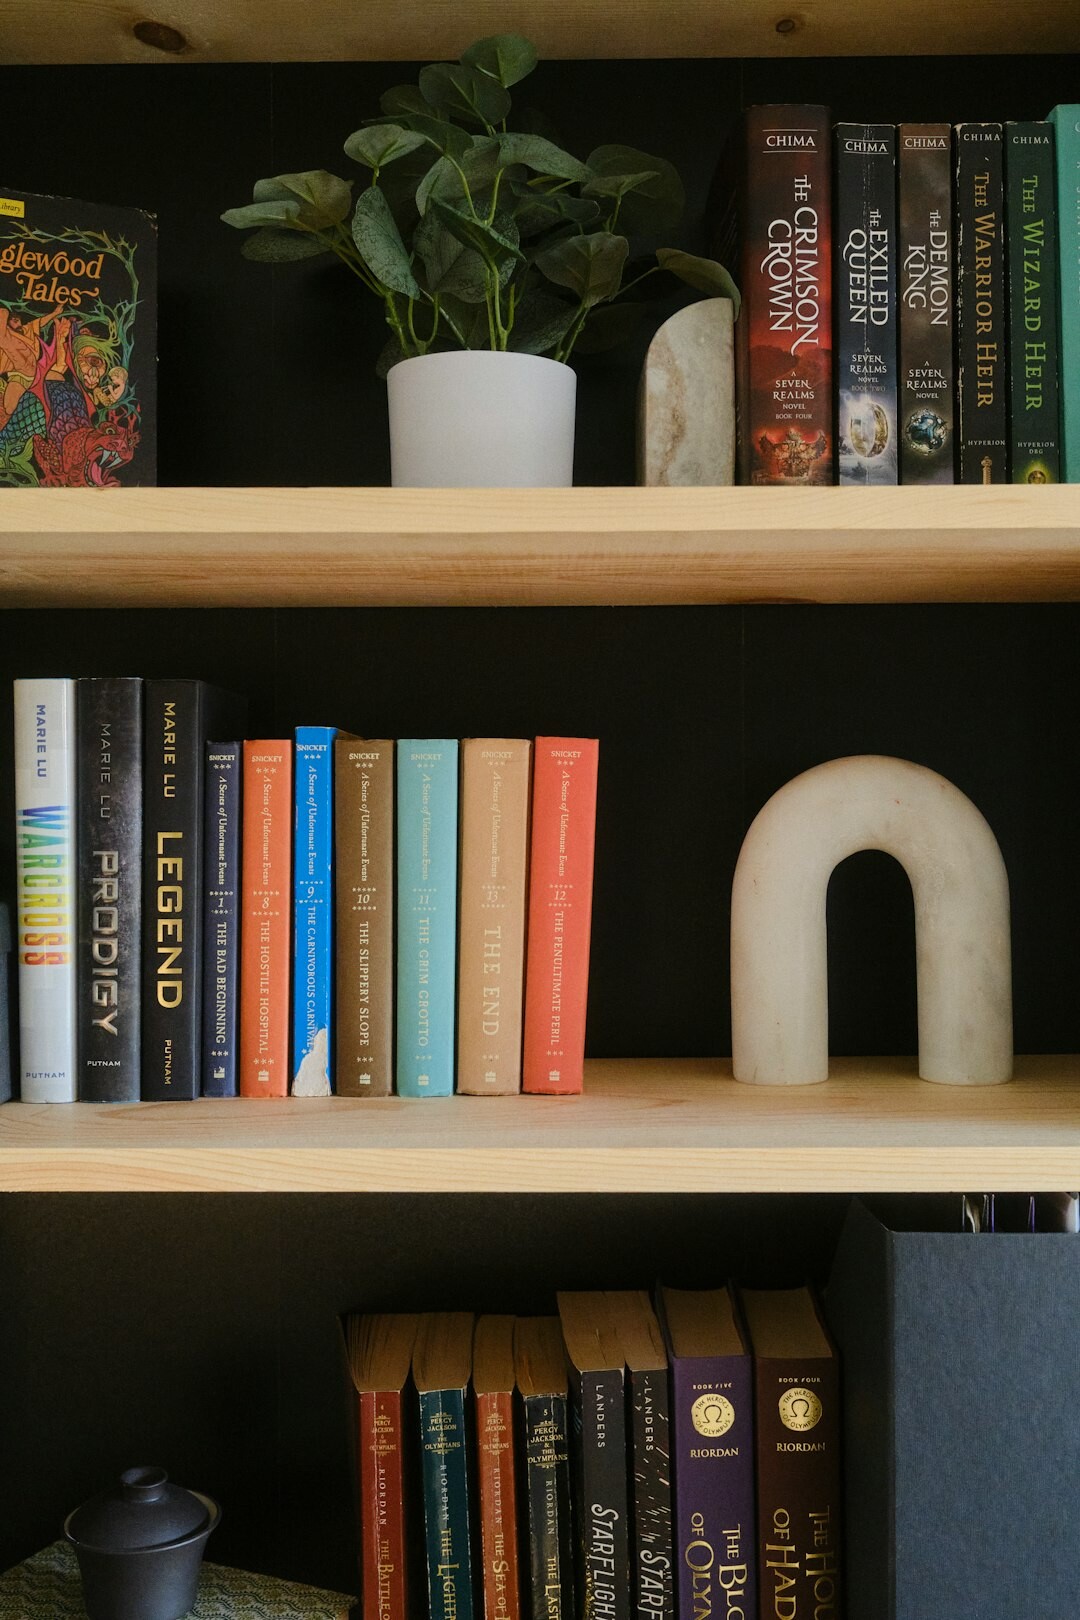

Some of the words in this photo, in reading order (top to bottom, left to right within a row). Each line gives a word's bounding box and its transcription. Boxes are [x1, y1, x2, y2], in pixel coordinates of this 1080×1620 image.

[766, 135, 816, 147] CHIMA
[845, 141, 888, 152] CHIMA
[904, 138, 946, 148] CHIMA
[963, 133, 1001, 141] CHIMA
[1012, 136, 1050, 144] CHIMA
[794, 174, 812, 202] THE
[974, 172, 990, 208] THE
[1022, 175, 1038, 213] THE
[0, 202, 21, 214] ibrary
[869, 208, 882, 227] THE
[929, 209, 941, 228] THE
[760, 218, 793, 332] CROWN
[791, 206, 819, 356] CRIMSON
[842, 228, 868, 325] QUEEN
[869, 229, 889, 326] EXILED
[902, 244, 930, 309] KING
[929, 230, 949, 327] DEMON
[974, 211, 996, 335] WARRIOR
[1022, 219, 1045, 332] WIZARD
[16, 271, 100, 306] Tales
[850, 364, 887, 375] REALMS
[851, 354, 885, 364] SEVEN
[775, 379, 812, 390] SEVEN
[906, 380, 948, 391] REALMS
[908, 369, 945, 379] SEVEN
[976, 342, 998, 408] HEIR
[1024, 341, 1047, 411] HEIR
[773, 391, 815, 402] REALMS
[36, 704, 47, 754] MARIE
[163, 702, 176, 765] MARIE
[100, 723, 111, 784] MARIE
[251, 755, 283, 763] SNICKET
[296, 744, 327, 752] SNICKET
[349, 752, 380, 760] SNICKET
[410, 753, 442, 761] SNICKET
[481, 751, 513, 759] SNICKET
[551, 750, 581, 758] SNICKET
[36, 759, 47, 778] LU
[163, 773, 176, 798] LU
[218, 784, 228, 806] Series
[308, 774, 317, 795] Series
[361, 780, 370, 802] Series
[561, 780, 570, 802] Series
[100, 795, 111, 819] LU
[217, 807, 226, 816] of
[306, 797, 317, 807] of
[359, 803, 370, 812] of
[559, 803, 570, 812] of
[218, 818, 228, 860] Unfortunate
[308, 808, 317, 851] Unfortunate
[361, 814, 370, 857] Unfortunate
[560, 814, 570, 854] Unfortunate
[218, 862, 228, 885] Events
[308, 852, 317, 875] Events
[361, 858, 370, 882] Events
[559, 855, 568, 877] Events
[19, 805, 71, 966] WARCROSS
[307, 886, 315, 898] 9
[487, 891, 499, 903] 13
[554, 890, 567, 901] 12
[217, 898, 224, 908] 1
[262, 898, 269, 909] 8
[356, 894, 370, 904] 10
[418, 894, 430, 905] 11
[157, 831, 184, 1009] LEGEND
[307, 906, 316, 926] THE
[554, 911, 564, 933] THE
[216, 922, 227, 946] THE
[260, 920, 270, 943] THE
[359, 921, 369, 945] THE
[419, 917, 430, 944] THE
[92, 850, 119, 1037] PRODIGY
[484, 925, 502, 974] THE
[216, 949, 227, 974] BAD
[260, 946, 270, 995] HOSTILE
[307, 928, 316, 998] CARNIVOROUS
[418, 949, 430, 985] GRIM
[359, 948, 369, 1004] SLIPPERY
[552, 936, 563, 1013] PENULTIMATE
[215, 976, 227, 1044] BEGINNING
[418, 989, 430, 1047] GROTTO
[482, 986, 501, 1036] END
[259, 998, 269, 1055] HOSPITAL
[359, 1007, 369, 1046] SLOPE
[550, 1015, 561, 1046] PERIL
[164, 1039, 172, 1086] PUTNAM
[25, 1071, 66, 1079] PUTNAM
[695, 1400, 705, 1410] THE
[706, 1396, 729, 1409] HEROES
[783, 1392, 793, 1404] THE
[430, 1417, 453, 1425] PERCY
[543, 1408, 548, 1416] 5
[595, 1384, 606, 1448] LANDERS
[644, 1387, 654, 1451] LANDERS
[790, 1411, 819, 1429] OLYMPUS
[427, 1424, 457, 1432] JACKSON
[530, 1434, 564, 1443] JACKSON
[534, 1426, 559, 1435] PERCY
[703, 1419, 730, 1435] OLYMPUS
[424, 1441, 461, 1450] OLYMPIANS
[690, 1447, 739, 1458] RIORDAN
[776, 1442, 826, 1452] RIORDAN
[528, 1454, 568, 1464] OLYMPIANS
[378, 1468, 387, 1525] RIORDAN
[440, 1465, 449, 1521] RIORDAN
[493, 1468, 502, 1524] RIORDAN
[546, 1480, 555, 1535] RIORDAN
[691, 1512, 704, 1537] OF
[773, 1507, 790, 1541] OF
[808, 1504, 830, 1547] THE
[380, 1539, 389, 1560] THE
[441, 1527, 453, 1556] THE
[495, 1533, 505, 1556] THE
[722, 1523, 741, 1560] THE
[547, 1556, 558, 1580] THE
[589, 1503, 619, 1620] STARFLIGH
[379, 1563, 394, 1610] BATTLE
[492, 1560, 511, 1592] SEA
[765, 1543, 800, 1620] HAD
[437, 1562, 459, 1620] LIGHT
[544, 1583, 561, 1620] LAST
[496, 1597, 507, 1612] OF
